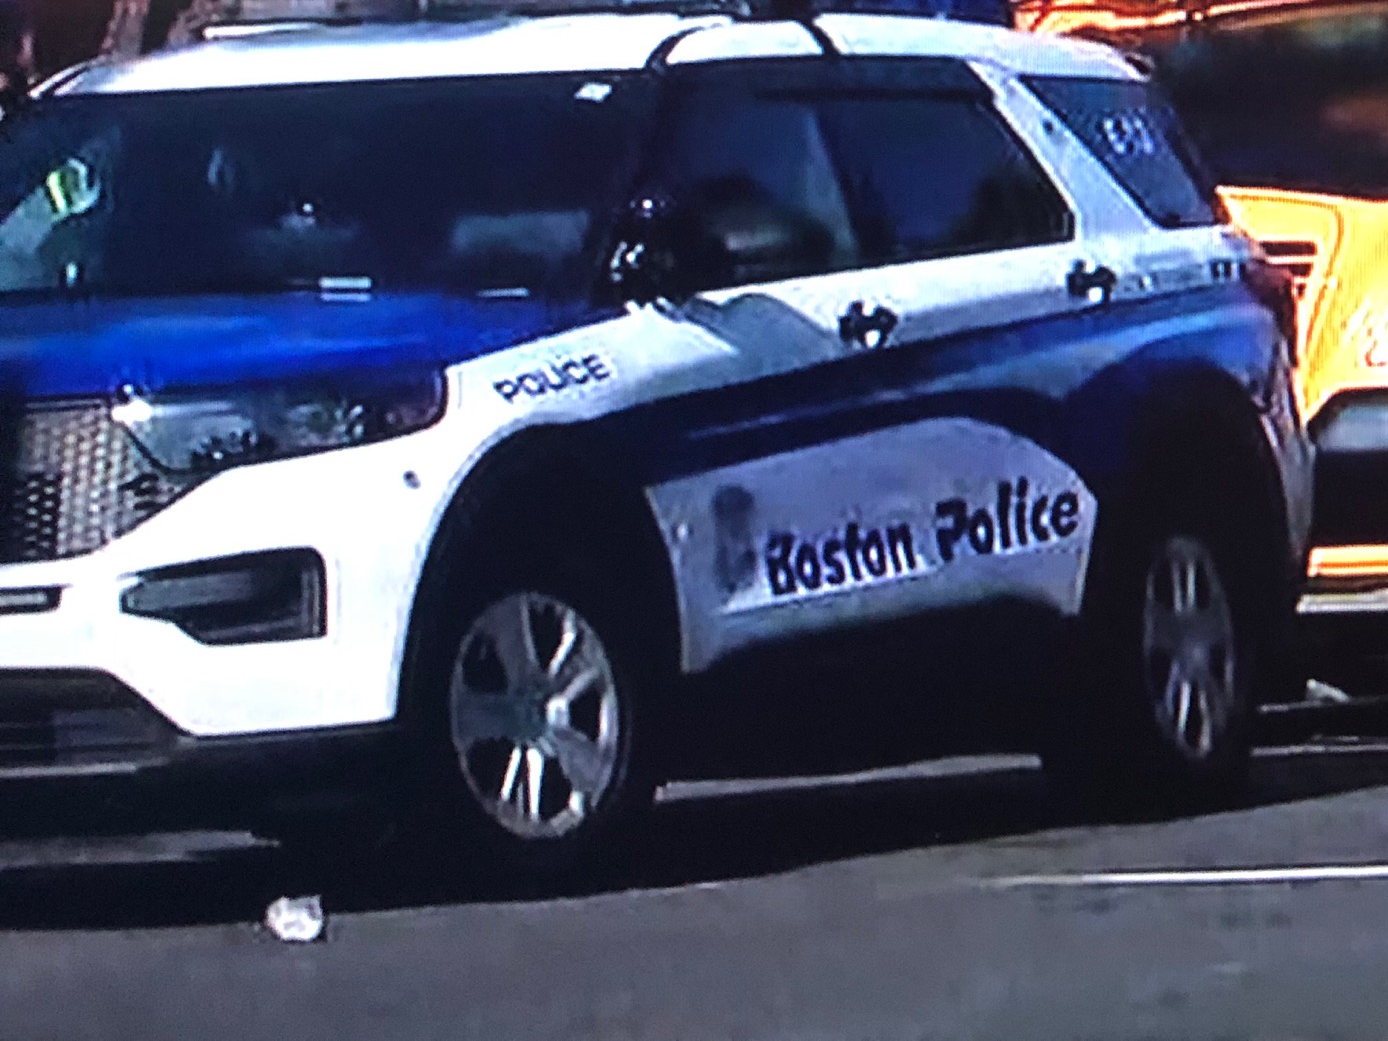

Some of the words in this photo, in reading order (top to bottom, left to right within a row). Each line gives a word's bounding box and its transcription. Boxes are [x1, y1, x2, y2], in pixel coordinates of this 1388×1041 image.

[493, 353, 611, 405] POLICE
[766, 521, 919, 596] Boston
[935, 476, 1081, 565] Police
